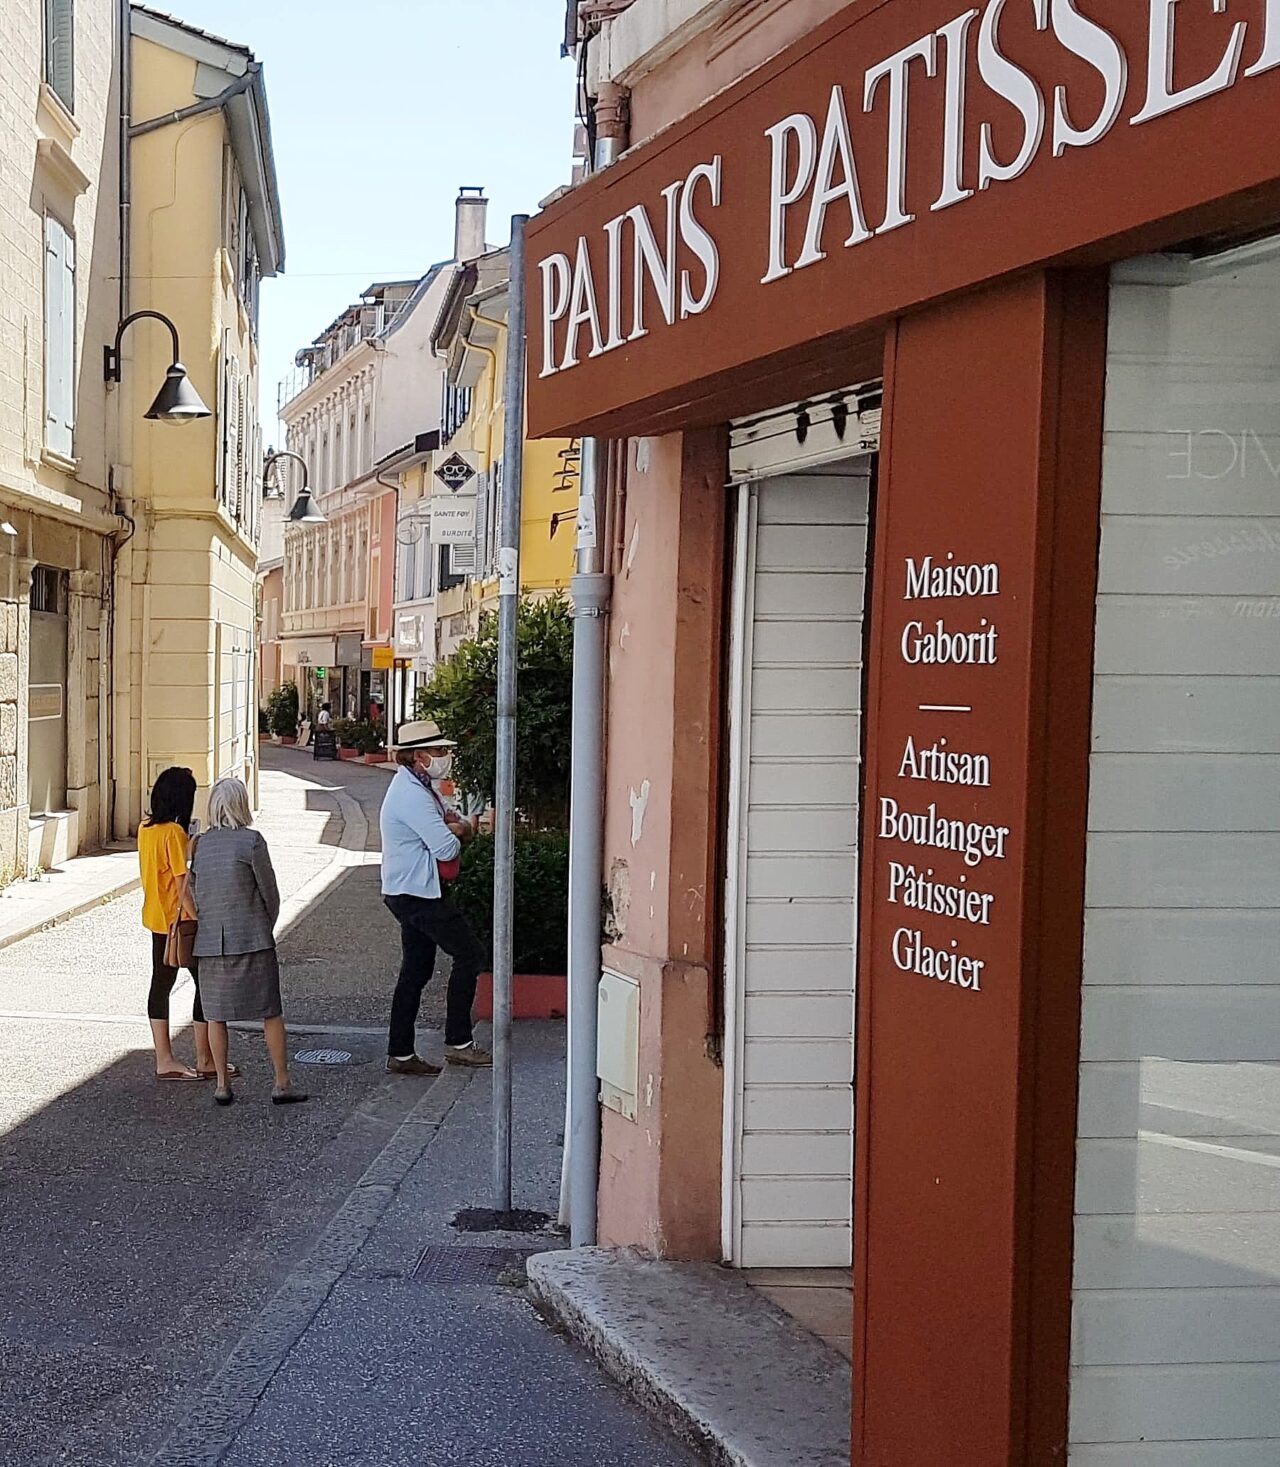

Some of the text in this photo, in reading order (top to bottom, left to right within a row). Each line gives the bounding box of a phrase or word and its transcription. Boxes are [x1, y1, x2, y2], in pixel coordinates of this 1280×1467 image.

[538, 0, 1280, 378] PAINS PATISSE
[904, 552, 999, 600] Maison
[901, 619, 998, 666] Gaborit
[897, 734, 991, 786] Artisan
[878, 797, 1008, 866] Boulanger
[888, 861, 993, 925] Pâtissier
[892, 928, 985, 992] Glacier
